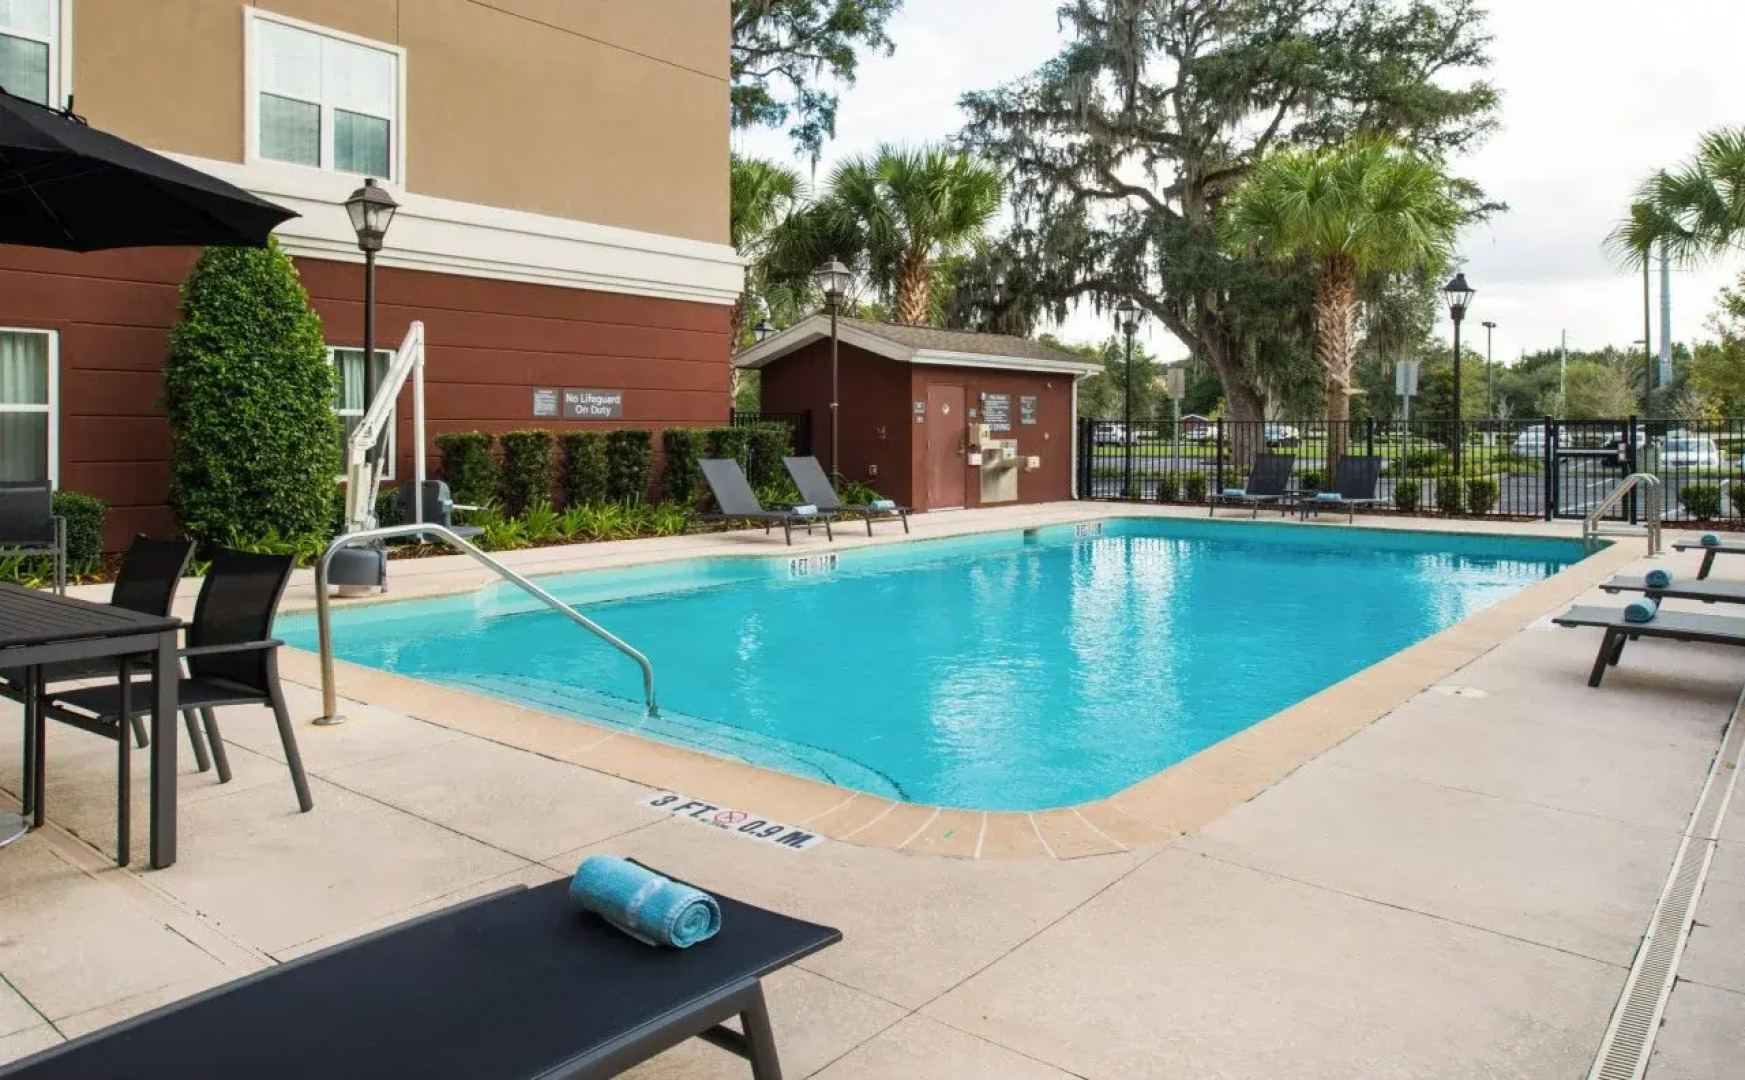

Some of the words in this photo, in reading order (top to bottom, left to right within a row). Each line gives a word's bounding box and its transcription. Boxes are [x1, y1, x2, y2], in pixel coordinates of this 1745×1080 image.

[565, 393, 578, 403] No
[580, 393, 620, 405] Lifeguard
[575, 405, 588, 414] On
[591, 405, 611, 417] Duty
[650, 795, 679, 807] 3
[737, 820, 784, 838] 0.9
